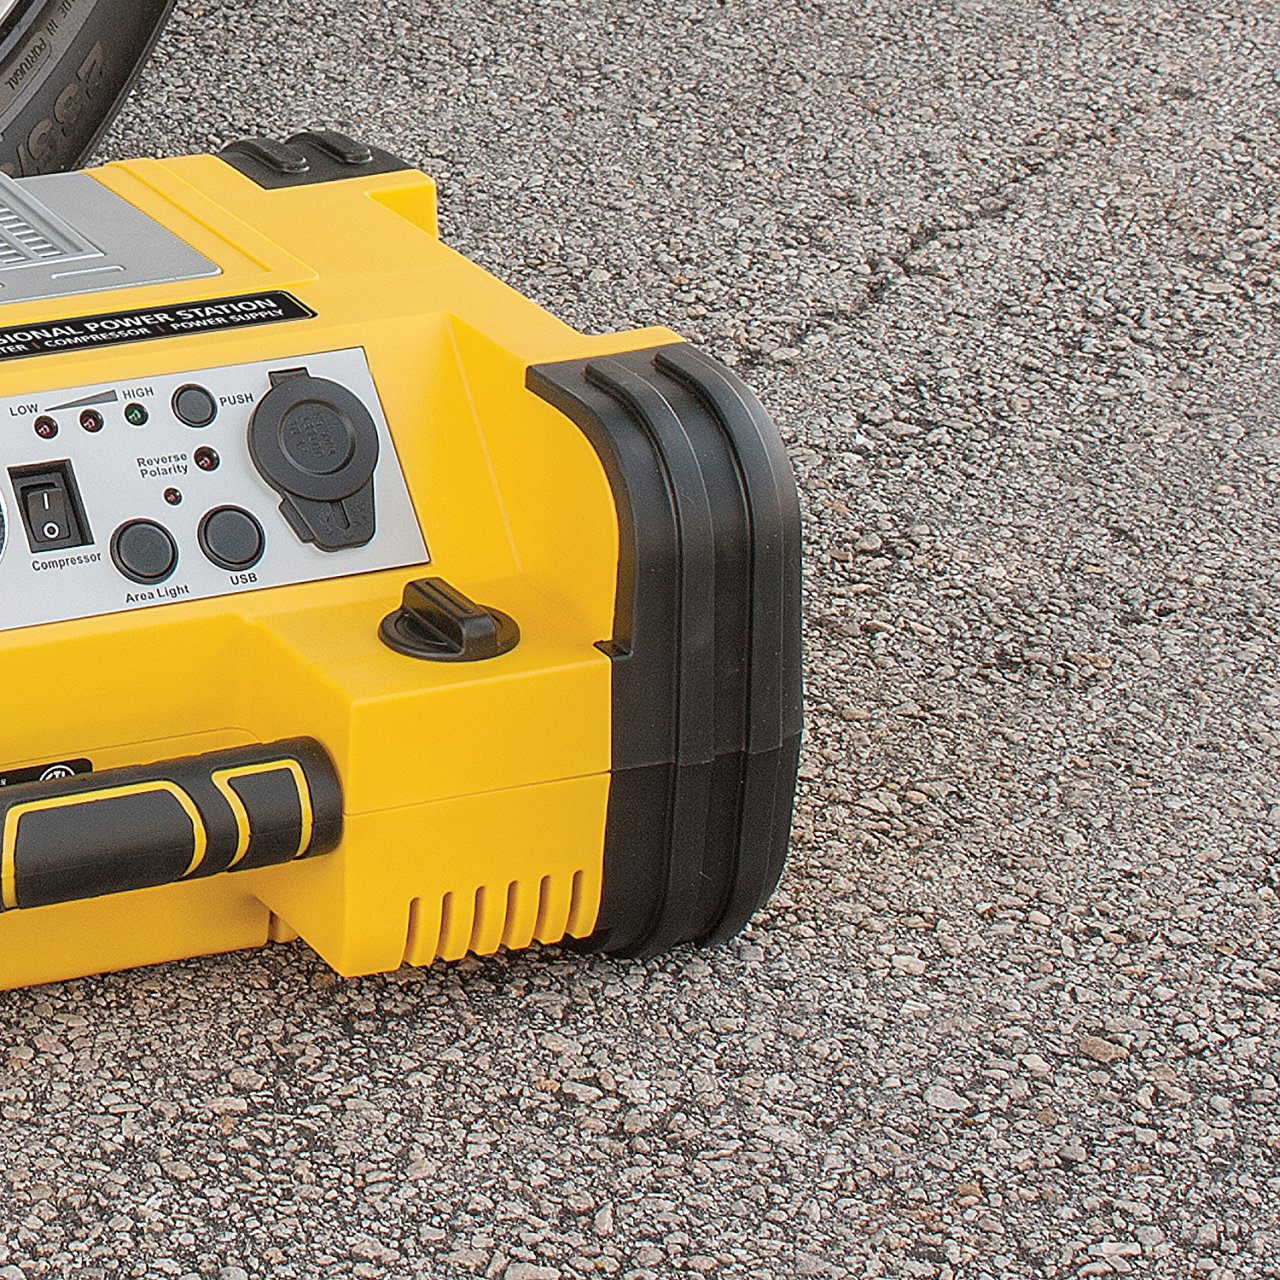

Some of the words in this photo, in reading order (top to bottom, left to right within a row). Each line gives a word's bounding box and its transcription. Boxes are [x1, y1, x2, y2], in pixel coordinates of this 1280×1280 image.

[45, 21, 58, 37] IN
[5, 38, 48, 90] PORTUGAL
[85, 310, 171, 336] POWER
[172, 297, 277, 324] STATION
[44, 326, 151, 349] COMPRESSOR
[171, 315, 228, 331] POWER
[229, 307, 285, 325] SUPPLY
[122, 386, 154, 400] HIGH
[219, 393, 255, 407] PUSH
[9, 403, 39, 418] LOW
[136, 452, 188, 468] Reverse
[140, 463, 189, 479] Polarity
[31, 552, 102, 571] Compressor
[230, 573, 258, 586] USB
[125, 590, 155, 603] Area
[157, 584, 190, 600] Light
